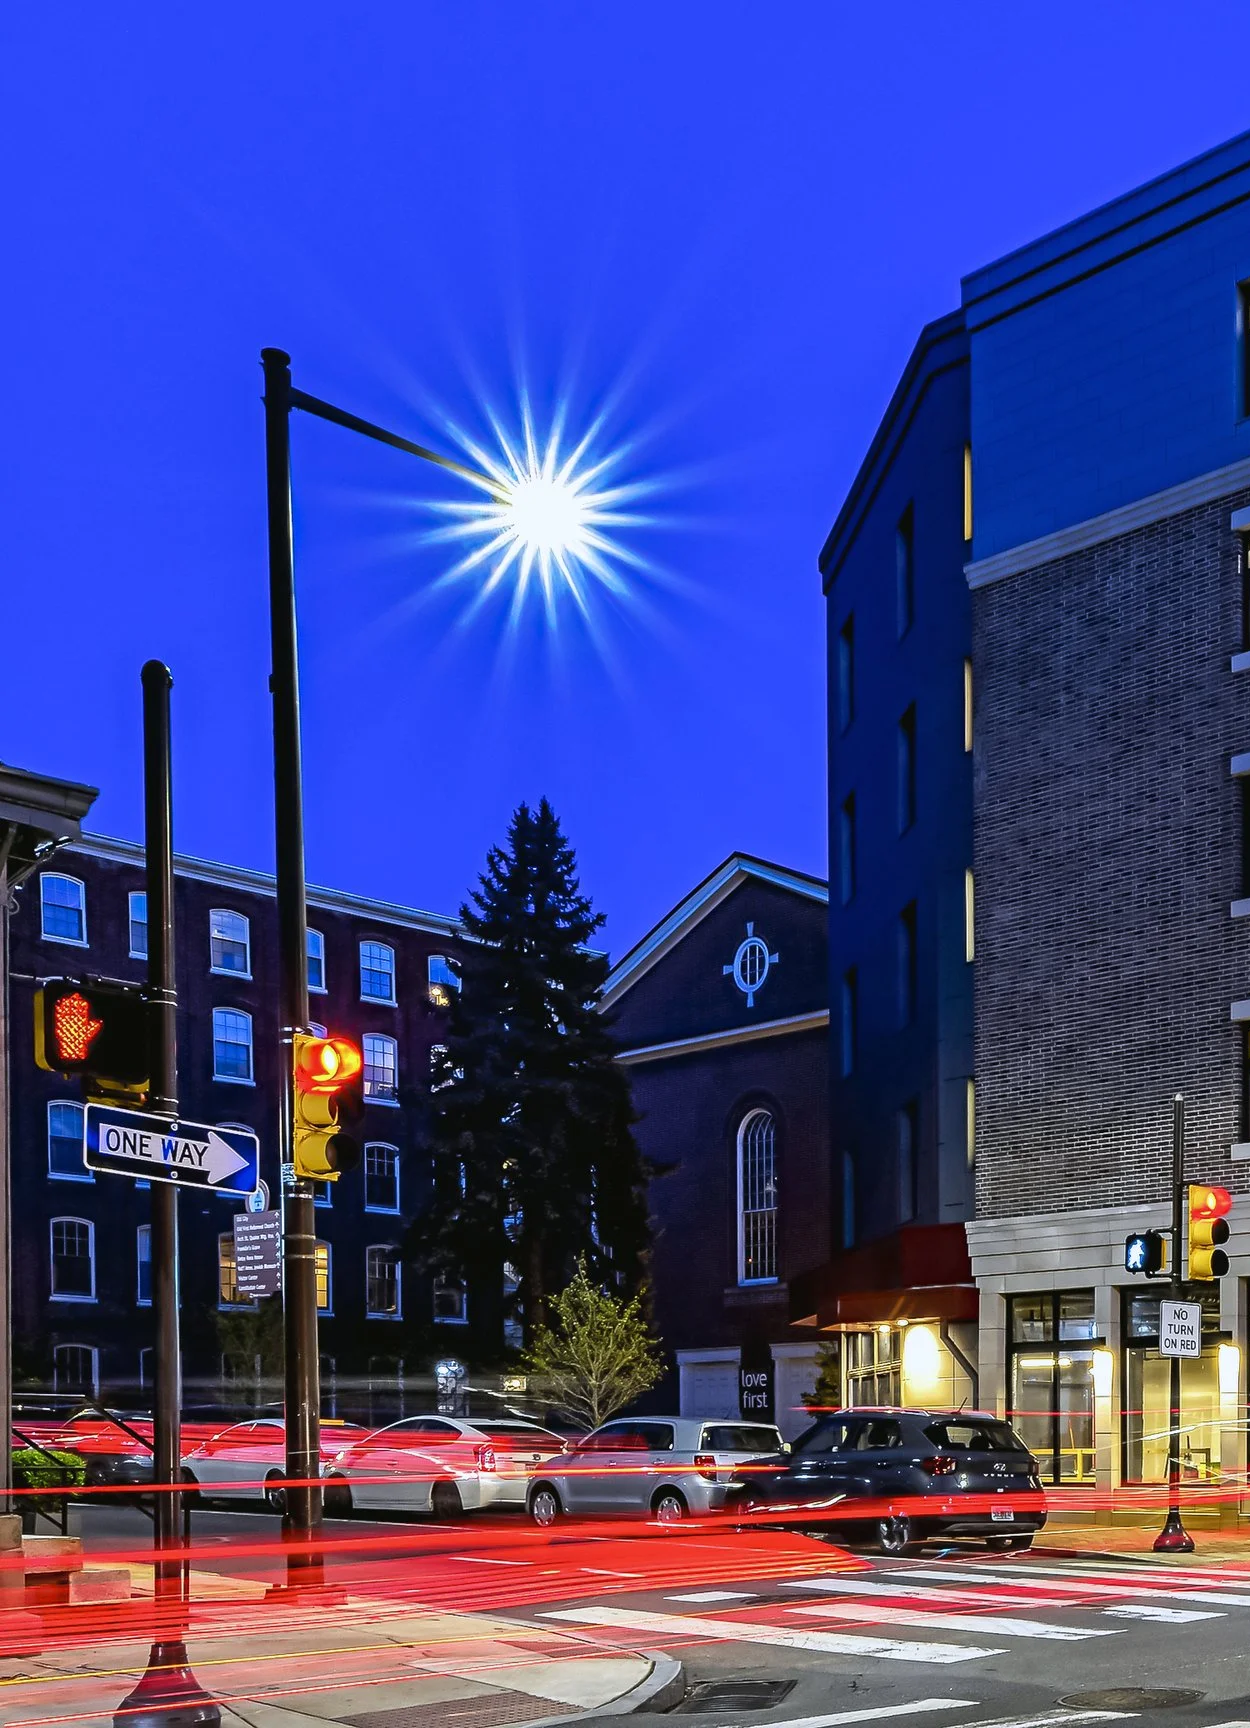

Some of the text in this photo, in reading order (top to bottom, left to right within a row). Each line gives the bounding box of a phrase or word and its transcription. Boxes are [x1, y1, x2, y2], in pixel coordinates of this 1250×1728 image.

[106, 1128, 208, 1167] ONE WAY
[1173, 1309, 1188, 1320] NO
[1167, 1323, 1194, 1336] TURN
[1164, 1338, 1197, 1351] ON RED
[741, 1369, 767, 1387] love
[743, 1390, 768, 1408] first
